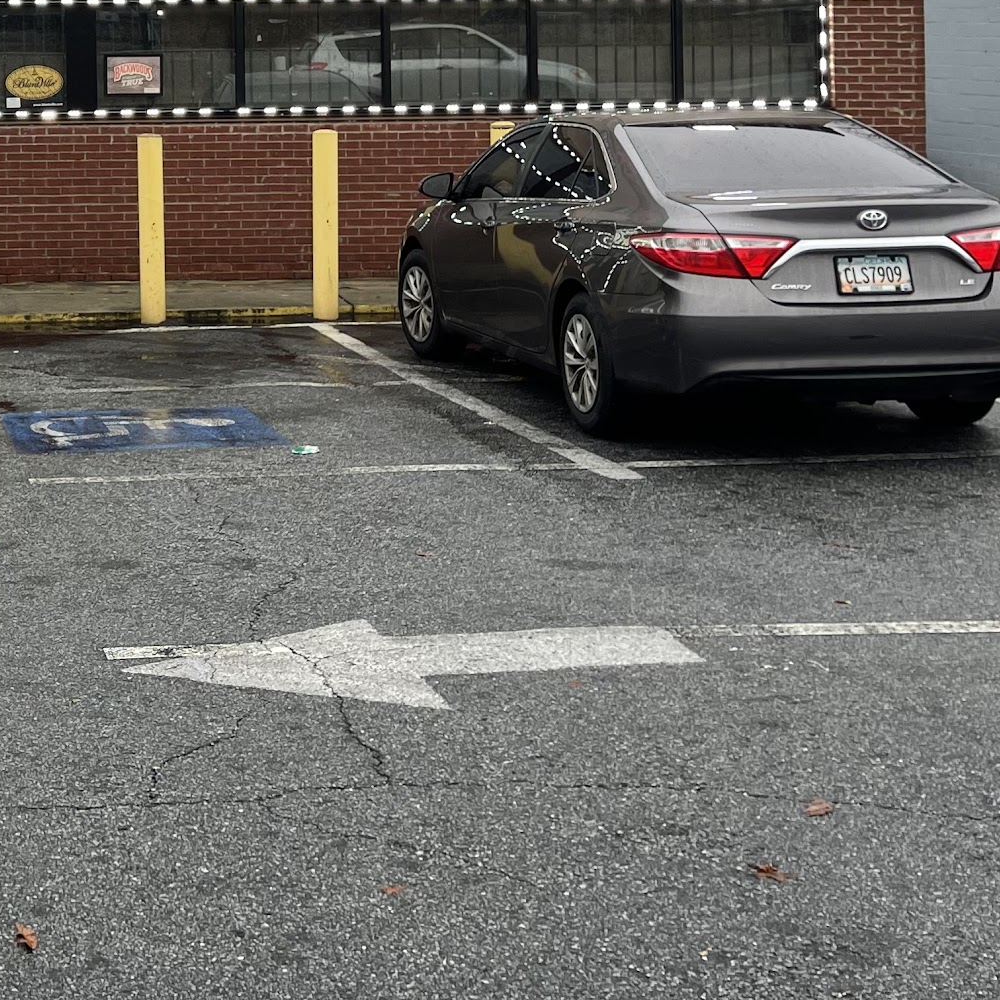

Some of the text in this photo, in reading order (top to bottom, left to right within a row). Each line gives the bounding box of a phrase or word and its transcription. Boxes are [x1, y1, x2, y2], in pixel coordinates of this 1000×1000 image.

[113, 62, 153, 82] BACKWOODS
[121, 77, 145, 87] TRUE
[863, 256, 904, 265] GEORA
[844, 266, 902, 284] CLS7909
